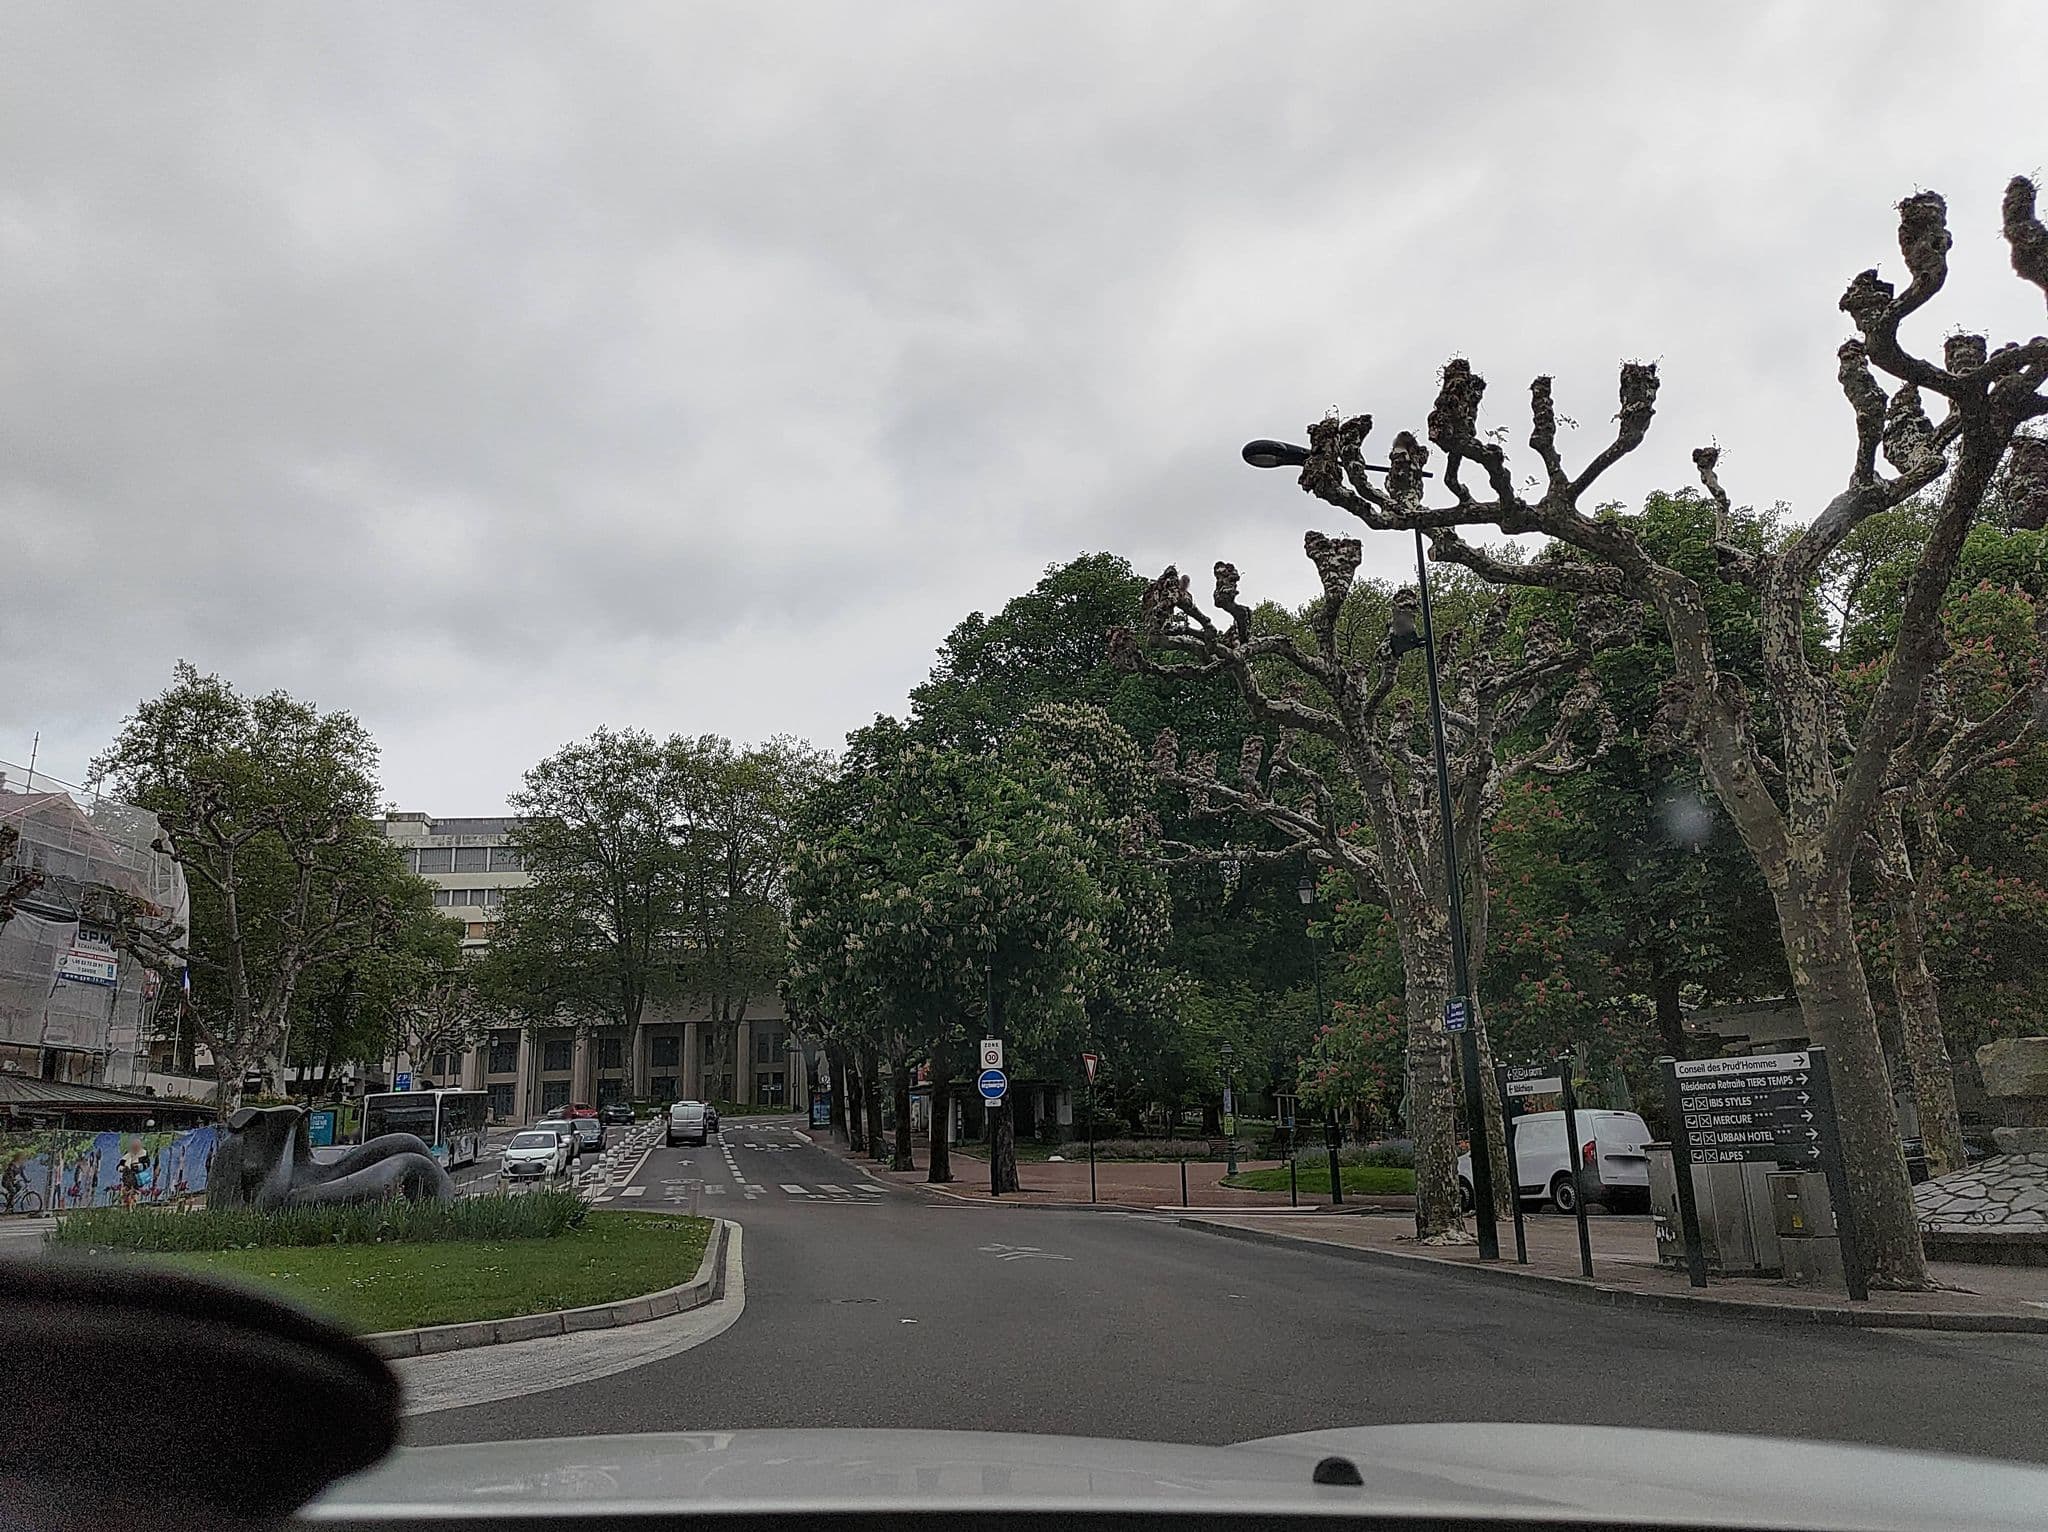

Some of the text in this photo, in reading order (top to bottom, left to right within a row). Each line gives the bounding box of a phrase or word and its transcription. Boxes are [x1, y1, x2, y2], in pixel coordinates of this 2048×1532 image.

[79, 930, 112, 946] GPM
[1679, 1060, 1777, 1074] Conseil des Prud'Hommes
[1680, 1075, 1794, 1092] Résidence Retraite TIERS TEMPS
[1709, 1097, 1752, 1107] IBIS STYLES
[1713, 1115, 1753, 1125] MERCURE
[1717, 1131, 1774, 1142] URBAN HOTEL
[1719, 1151, 1744, 1161] ALPES
